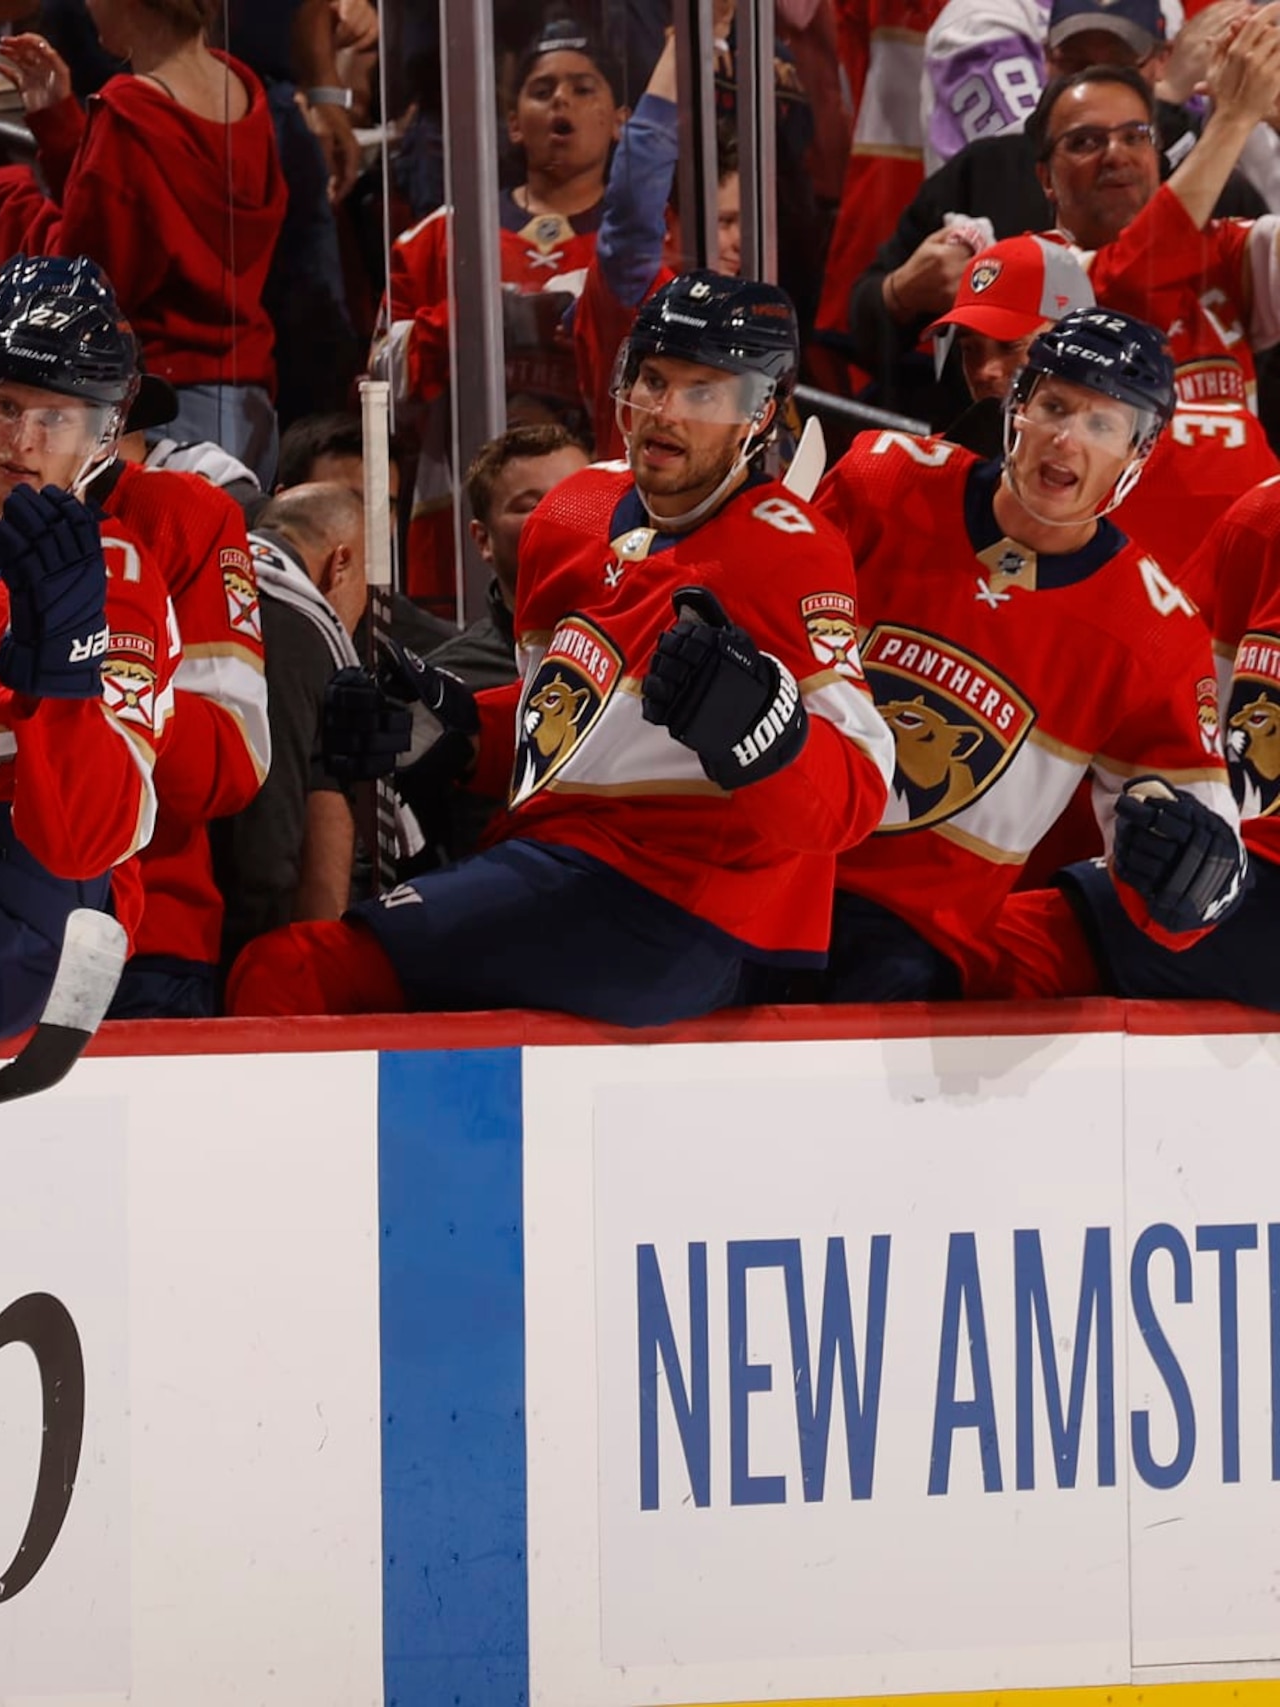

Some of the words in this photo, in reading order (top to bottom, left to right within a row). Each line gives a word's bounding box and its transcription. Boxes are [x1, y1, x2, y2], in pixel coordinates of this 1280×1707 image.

[950, 56, 1042, 143] 28
[29, 307, 70, 329] 27
[1087, 313, 1127, 333] 42
[1065, 344, 1115, 367] CCM
[752, 498, 817, 534] 8
[807, 596, 851, 610] FLORIDA
[1137, 554, 1197, 618] 4
[547, 628, 610, 684] PANTHERS
[878, 637, 1016, 731] PANTHERS
[635, 1233, 892, 1512] NEW
[927, 1222, 1280, 1497] AMST
